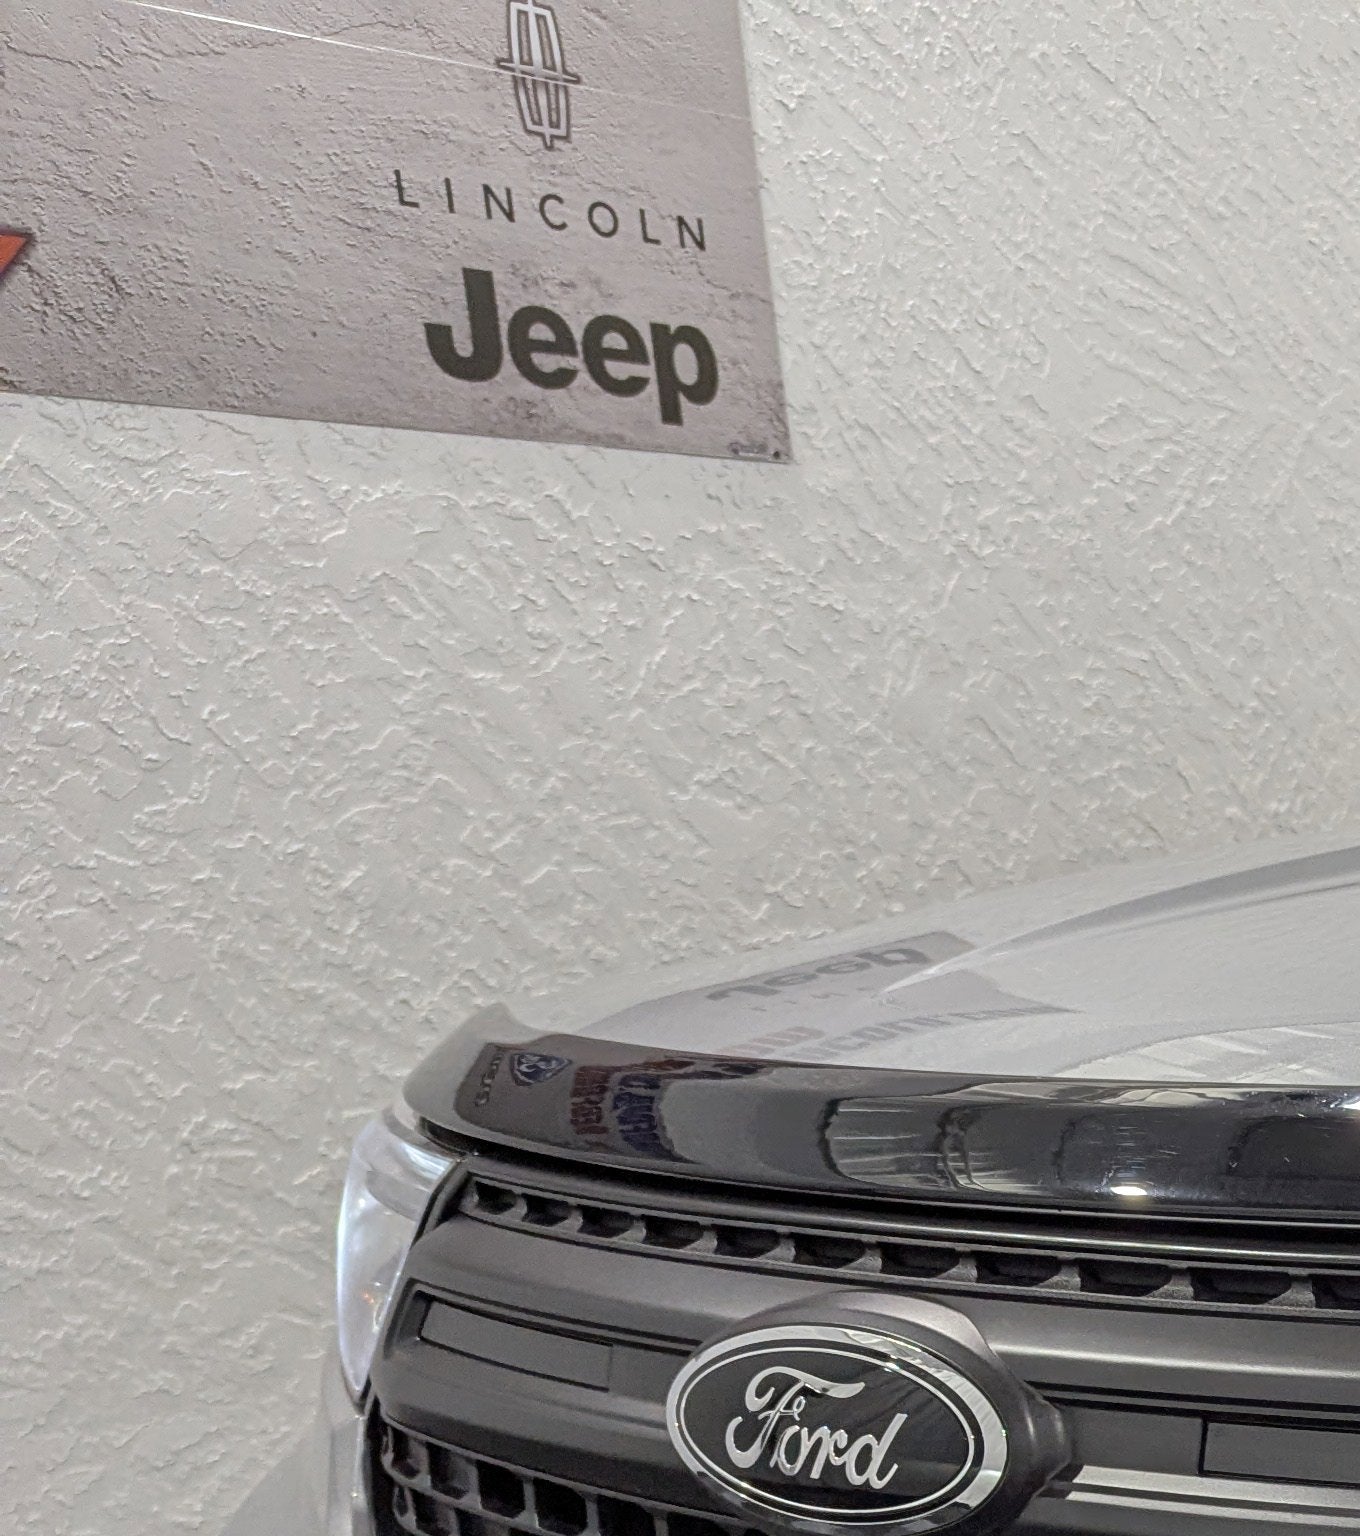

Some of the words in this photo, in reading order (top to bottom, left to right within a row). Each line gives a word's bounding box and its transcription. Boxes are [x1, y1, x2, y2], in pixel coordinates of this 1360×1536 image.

[394, 169, 706, 251] LINCOLN
[424, 267, 719, 426] Jeep
[725, 1366, 908, 1489] Ford
